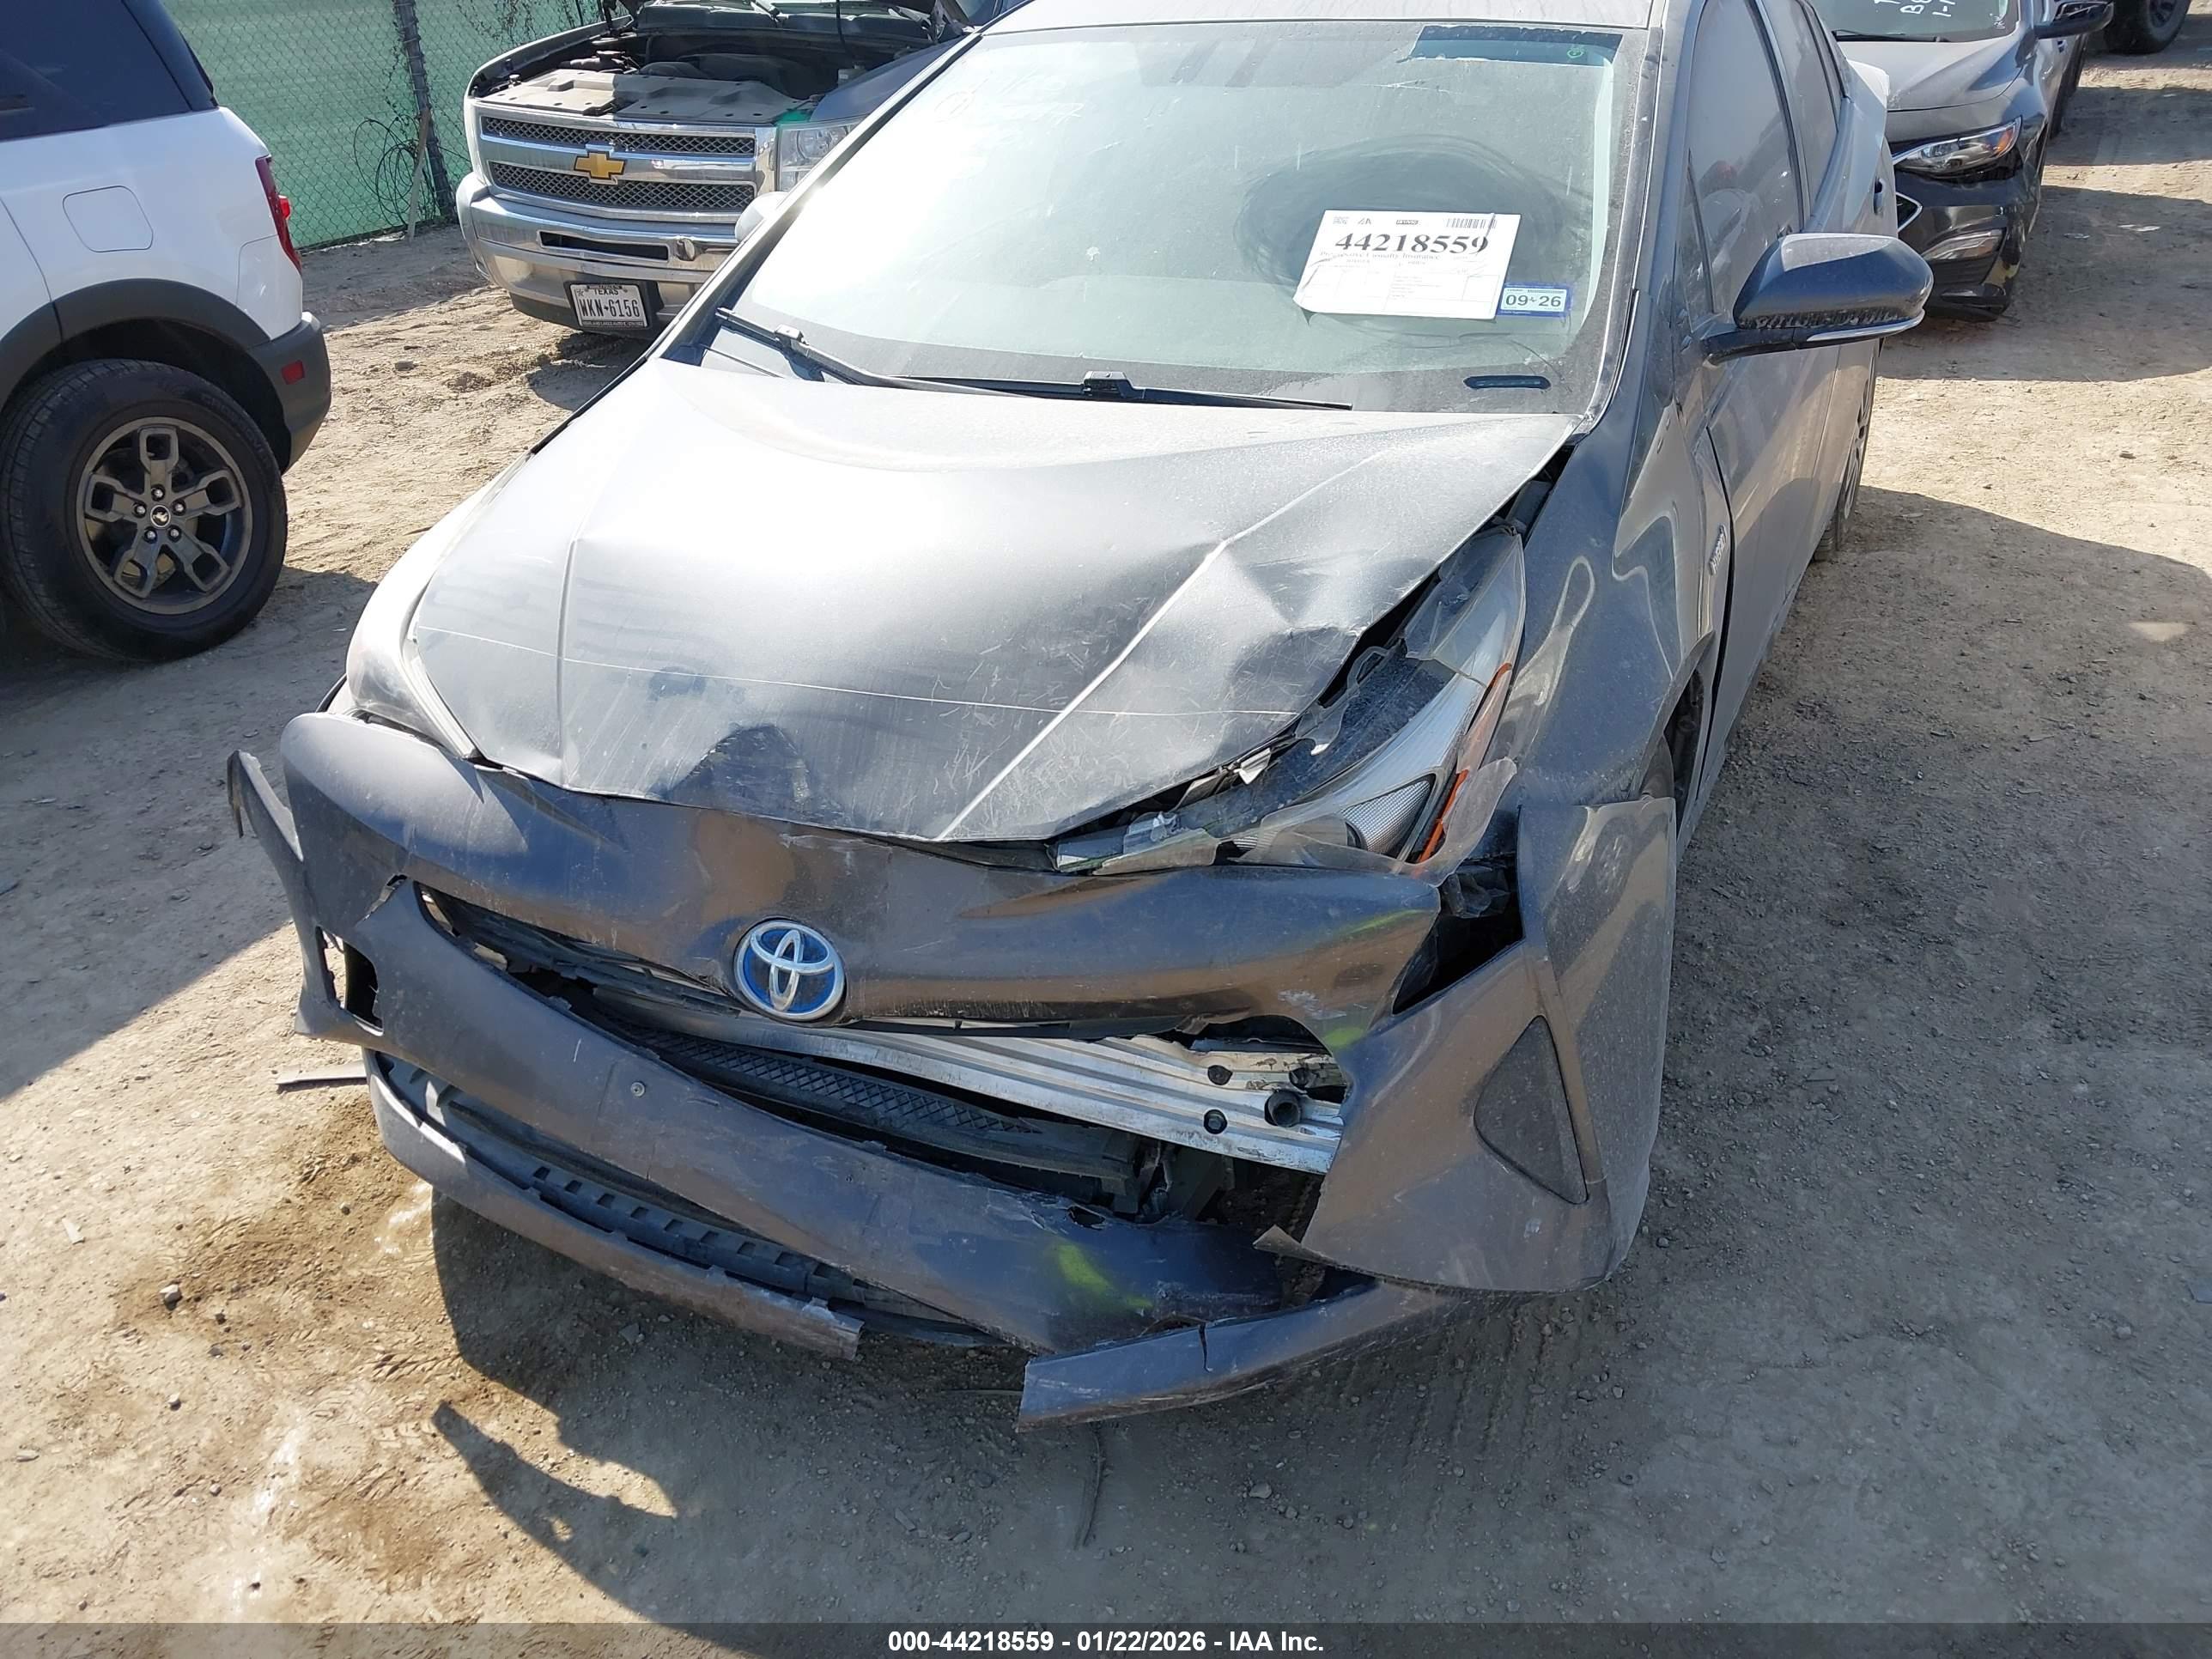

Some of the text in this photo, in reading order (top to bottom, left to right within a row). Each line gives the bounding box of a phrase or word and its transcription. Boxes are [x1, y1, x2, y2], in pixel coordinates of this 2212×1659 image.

[1334, 233, 1489, 255] 44218559
[1505, 295, 1562, 307] 09 26
